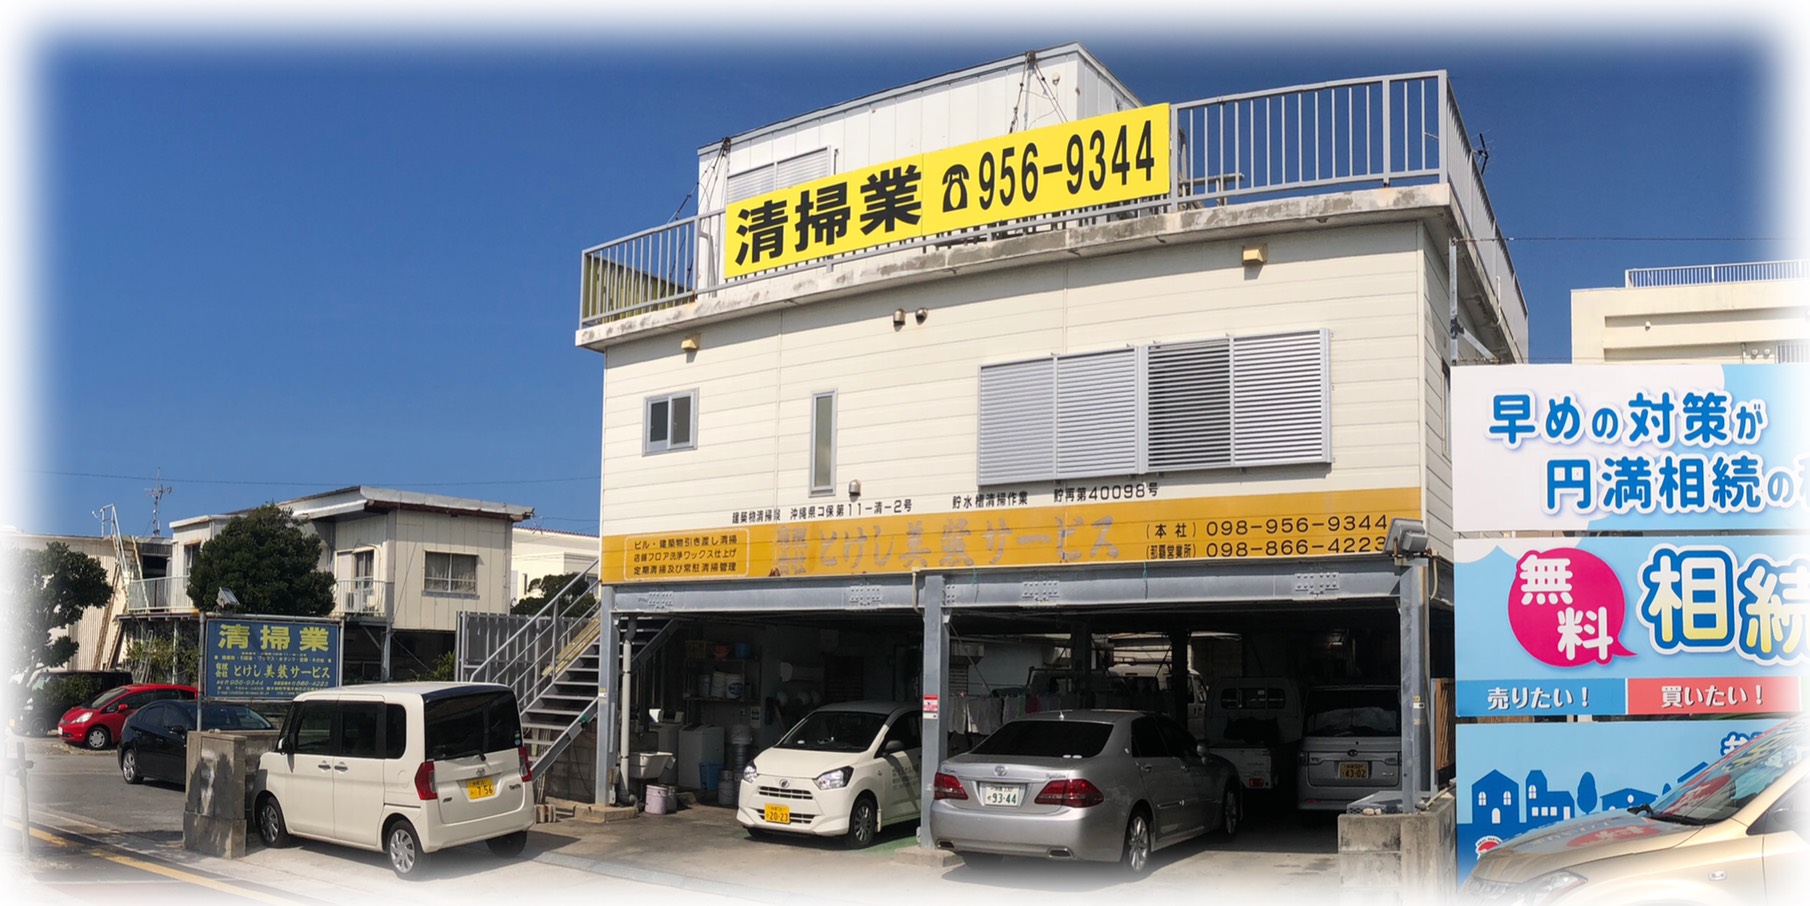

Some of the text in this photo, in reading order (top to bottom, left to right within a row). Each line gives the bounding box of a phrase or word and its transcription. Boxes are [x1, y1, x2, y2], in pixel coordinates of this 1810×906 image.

[735, 119, 1156, 267] 清掃業 956-9344
[1489, 391, 1765, 445] 早めの対策が
[1546, 455, 1810, 511] 円満相続の
[1206, 514, 1388, 537] 098-956-9344
[1206, 536, 1386, 559] 098-866-4223
[218, 623, 330, 652] 清掃業
